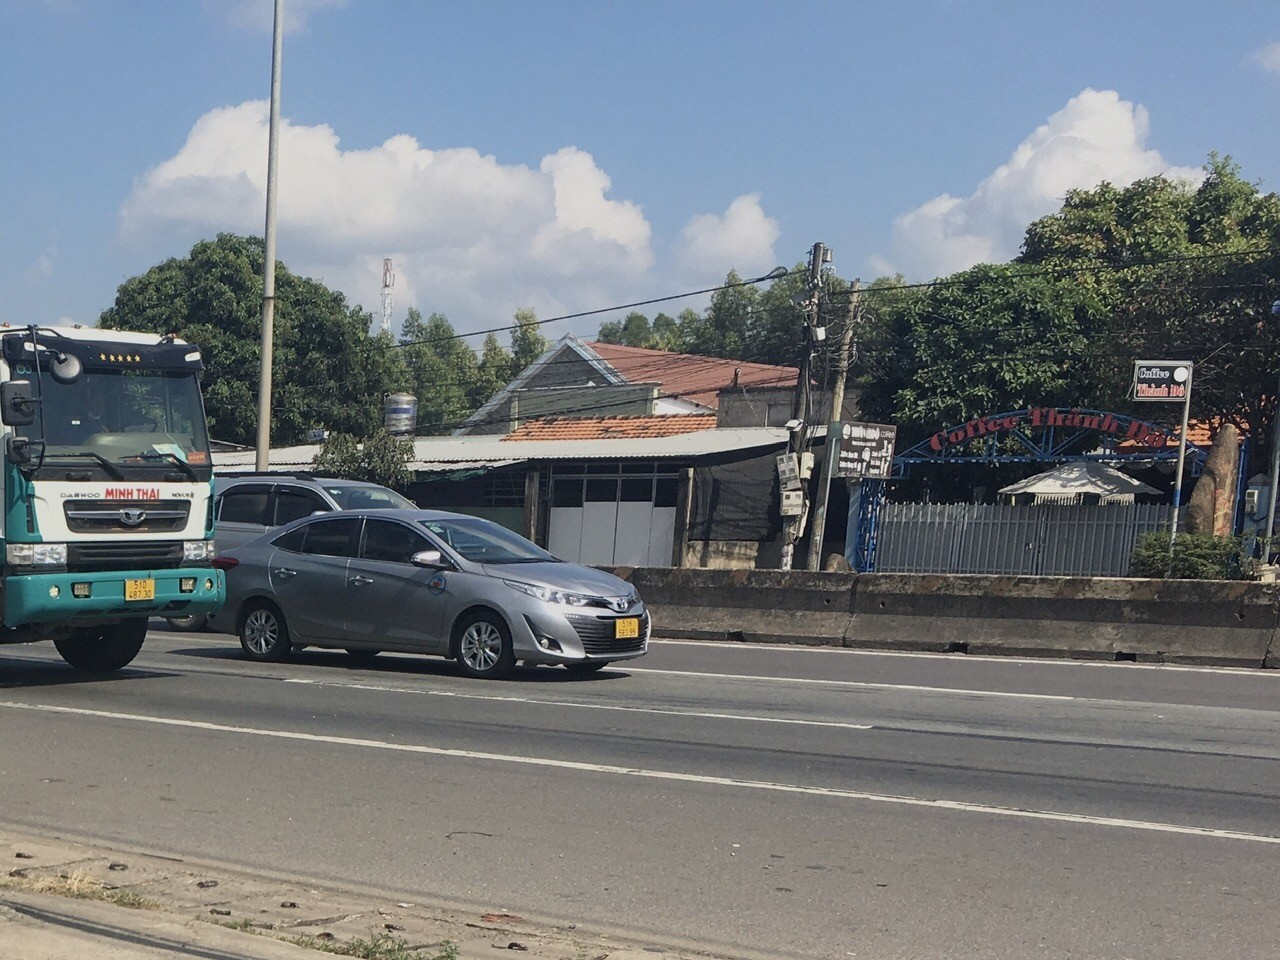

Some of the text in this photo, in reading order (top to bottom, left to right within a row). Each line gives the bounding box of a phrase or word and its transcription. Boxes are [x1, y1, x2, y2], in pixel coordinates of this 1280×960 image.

[1138, 367, 1170, 379] Coffee
[930, 415, 1021, 452] Coffee
[104, 488, 134, 500] MINH
